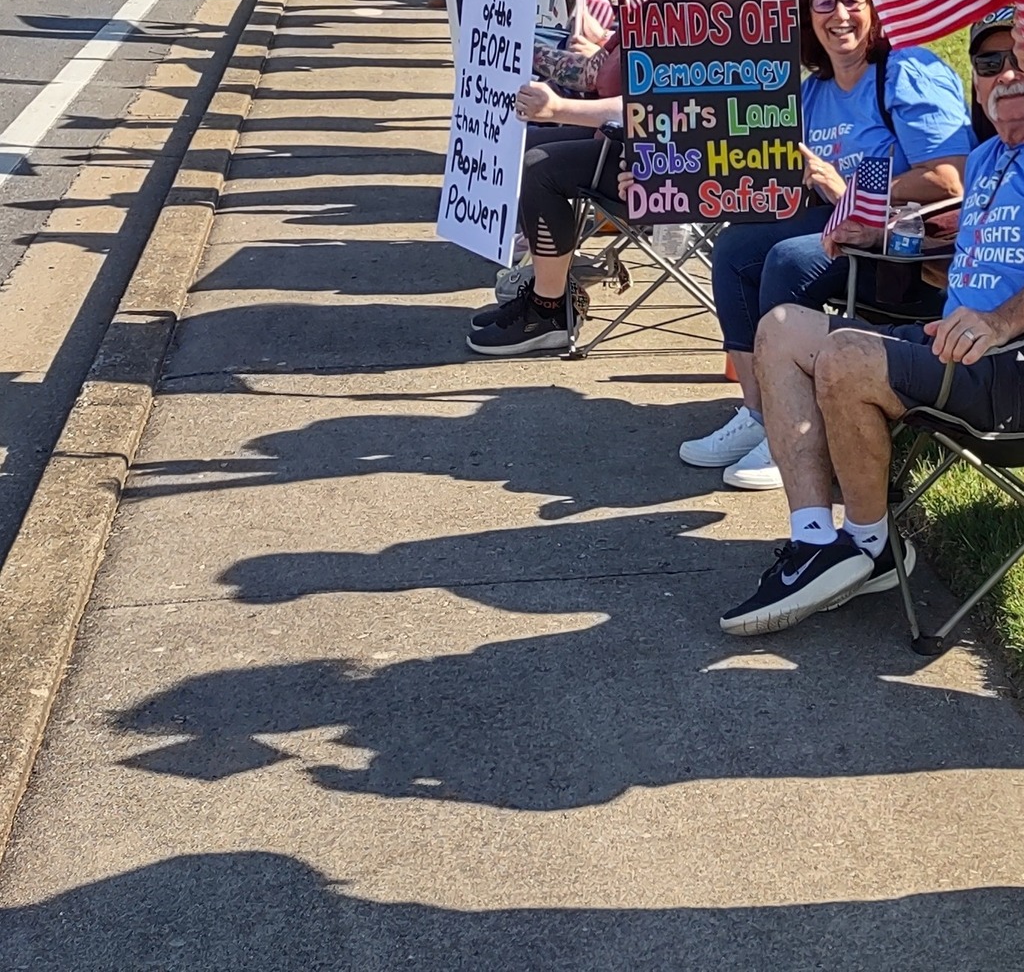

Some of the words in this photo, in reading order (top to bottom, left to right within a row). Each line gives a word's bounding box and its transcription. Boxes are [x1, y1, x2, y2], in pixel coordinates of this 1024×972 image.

[483, 1, 496, 30] of
[495, 1, 512, 27] the
[620, 0, 733, 49] HANDS
[469, 28, 522, 75] PEOPLE
[627, 50, 791, 96] Democracy
[460, 68, 471, 99] is
[475, 73, 516, 125] Stronge
[626, 98, 717, 143] Rights
[727, 94, 798, 136] Land
[455, 106, 480, 134] than
[483, 109, 500, 143] the
[451, 137, 488, 191] People
[492, 157, 504, 186] in
[631, 141, 702, 181] Jobs
[706, 138, 803, 177] Health
[626, 179, 690, 220] Data
[699, 176, 802, 220] Safety
[974, 226, 1021, 244] RIGHTS
